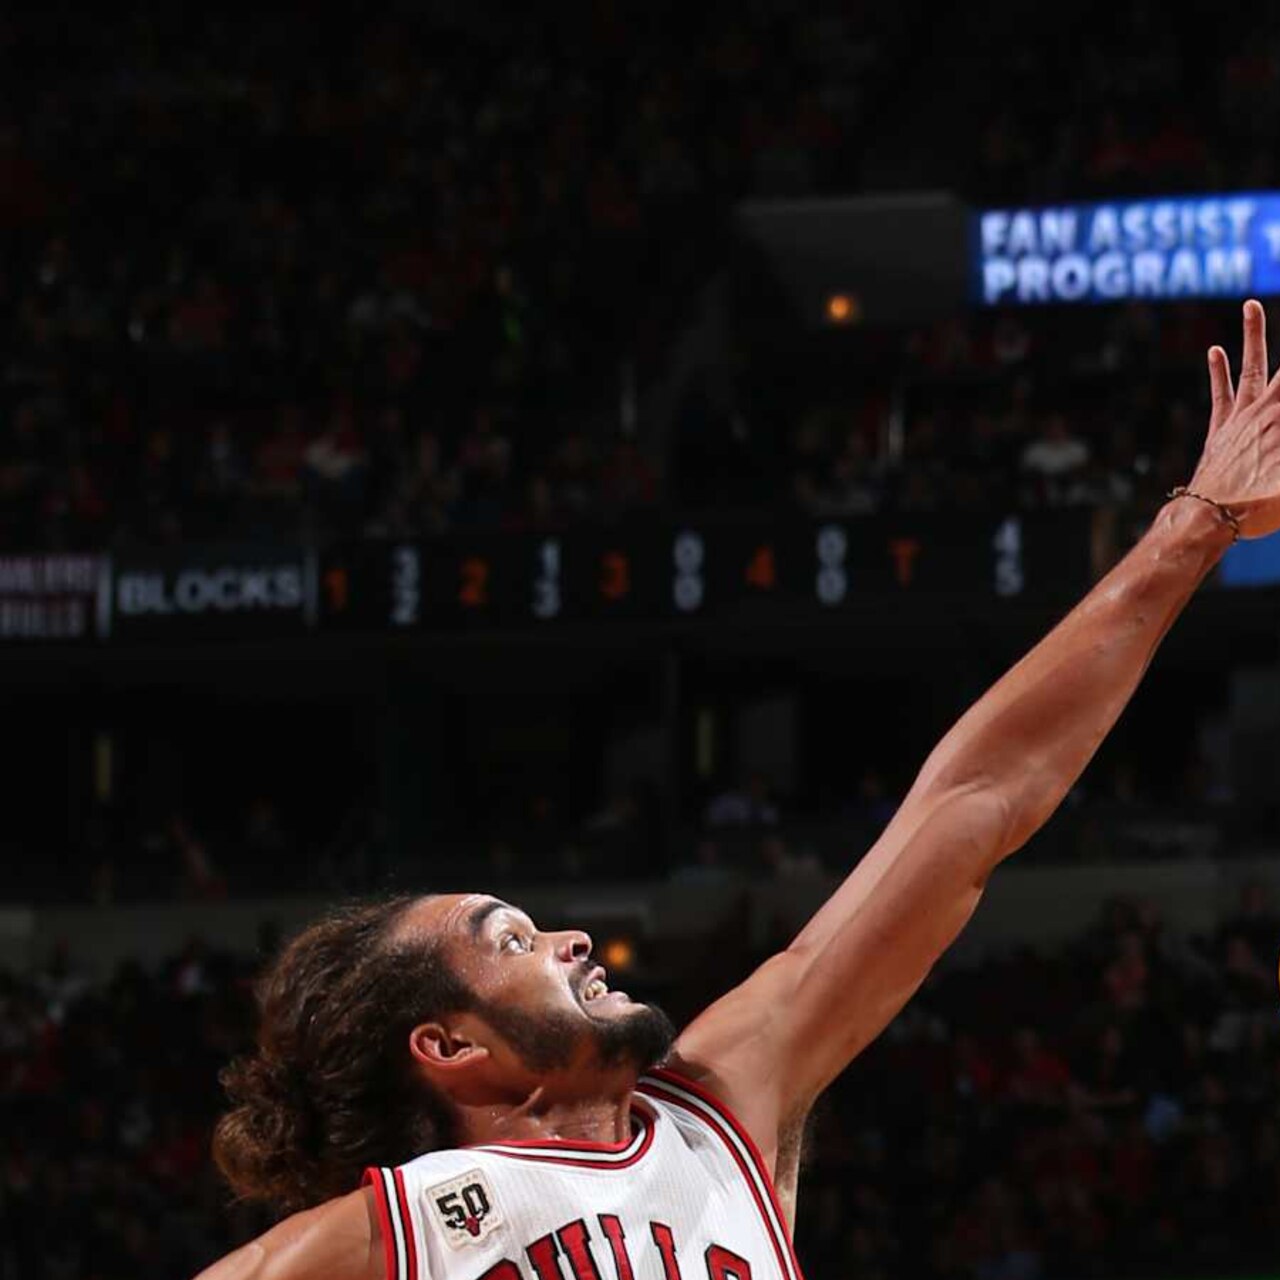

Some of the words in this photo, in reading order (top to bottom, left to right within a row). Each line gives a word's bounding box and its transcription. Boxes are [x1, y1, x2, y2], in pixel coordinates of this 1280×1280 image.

[980, 209, 1077, 256] FAN
[1089, 200, 1253, 252] ASSIST
[983, 249, 1252, 302] PROGRAM
[117, 566, 301, 615] BLOCKS
[324, 566, 349, 613] 1
[458, 554, 489, 610] 2
[599, 549, 630, 602] 3
[744, 544, 776, 591] 4
[887, 536, 922, 589] T
[436, 1183, 490, 1229] 50
